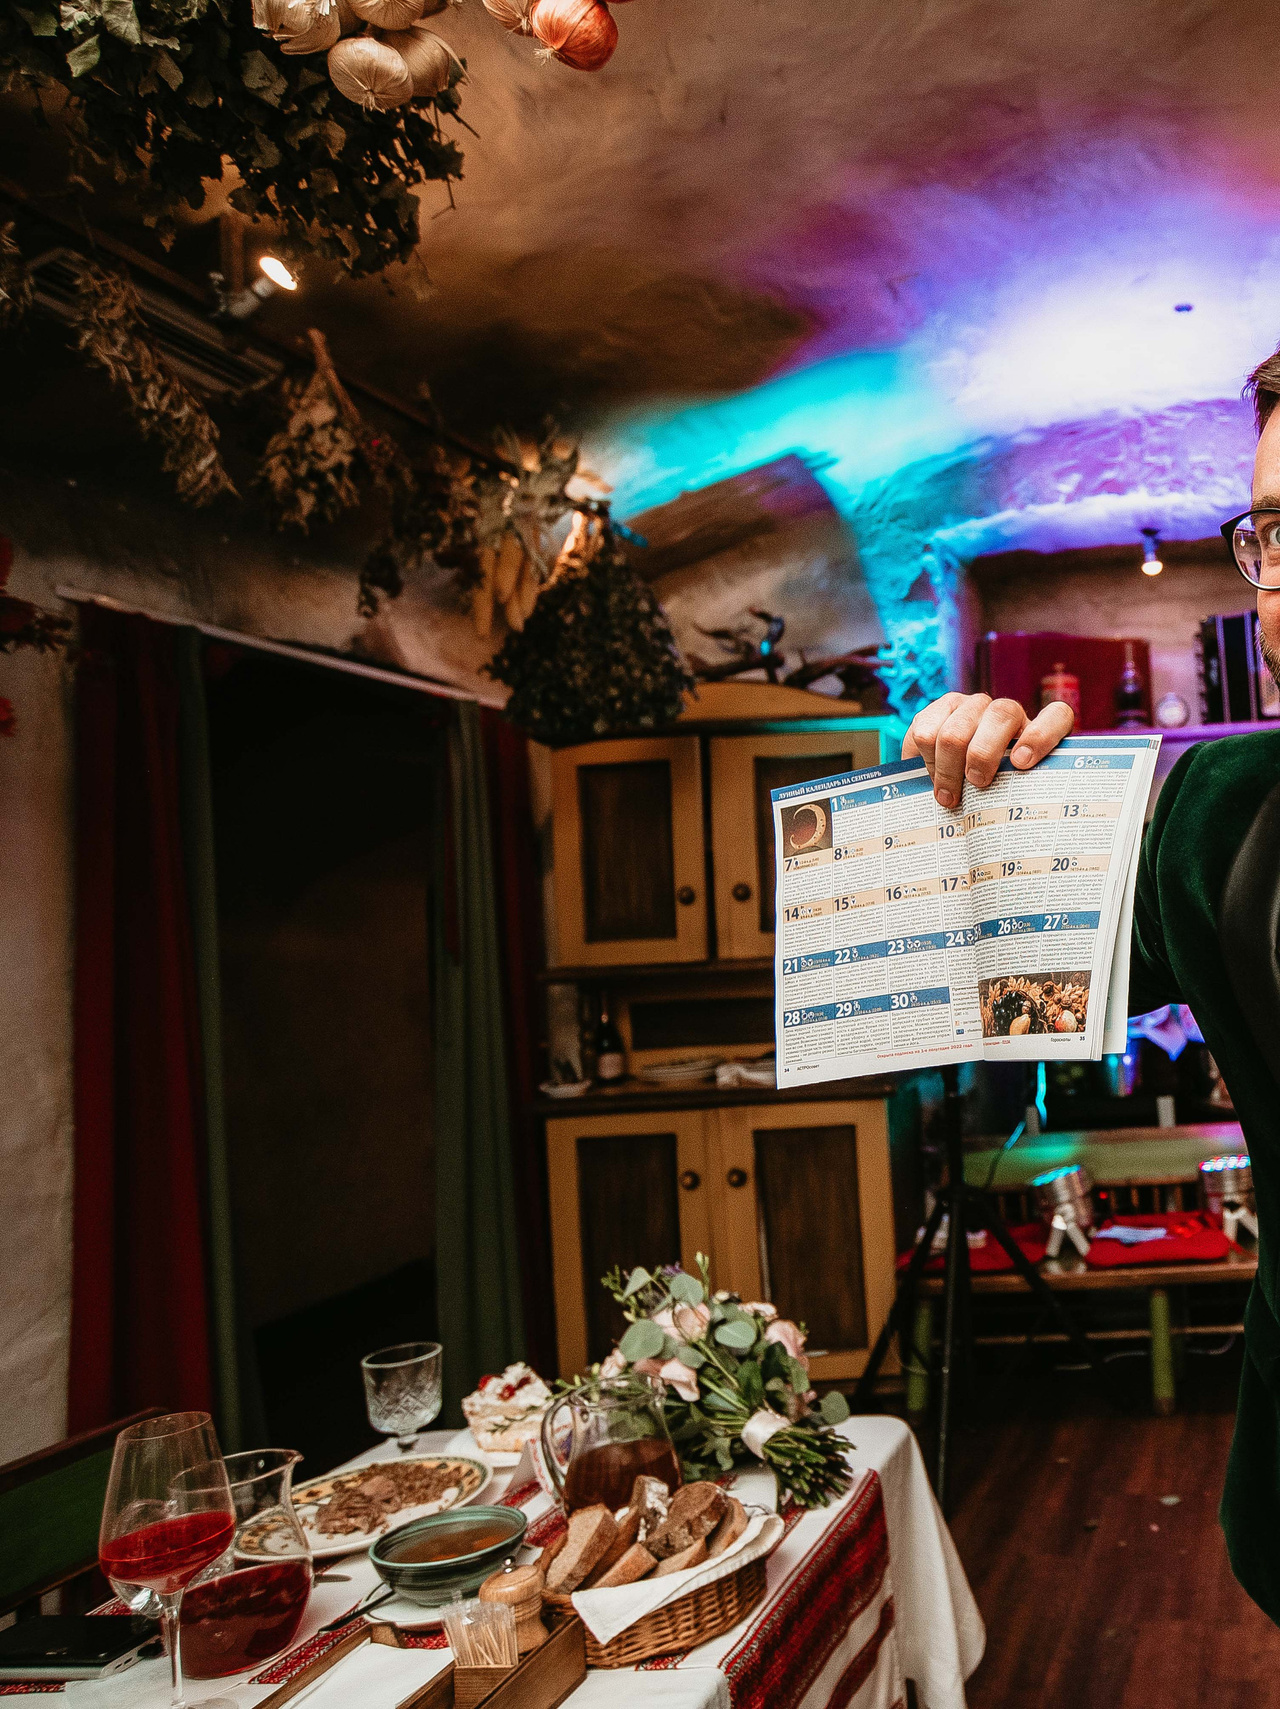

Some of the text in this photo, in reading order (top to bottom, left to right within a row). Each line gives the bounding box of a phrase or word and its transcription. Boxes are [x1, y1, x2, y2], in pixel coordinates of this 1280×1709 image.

[1074, 757, 1084, 768] 6
[778, 788, 805, 799] ЛУННЫЙ
[806, 780, 842, 792] КАЛЕНДАРЬ
[851, 770, 882, 784] СЕНТЯБРЬ
[882, 786, 892, 800] 2
[832, 798, 838, 810] 1
[1063, 804, 1078, 817] 13
[968, 814, 976, 829] 11
[1008, 808, 1023, 821] 12
[938, 825, 954, 838] 10
[884, 836, 892, 849] 9
[834, 848, 842, 860] 8
[785, 859, 792, 872] 7
[1001, 862, 1015, 876] 19
[1052, 857, 1070, 871] 20
[942, 878, 958, 891] 17
[886, 886, 902, 900] 16
[834, 897, 848, 911] 15
[784, 908, 799, 921] 14
[998, 920, 1010, 934] 26
[1044, 914, 1060, 930] 27
[946, 932, 965, 946] 24
[888, 940, 904, 954] 23
[835, 948, 850, 964] 22
[784, 958, 798, 974] 21
[890, 994, 908, 1009] 30
[836, 1002, 852, 1017] 29
[784, 1013, 800, 1026] 28
